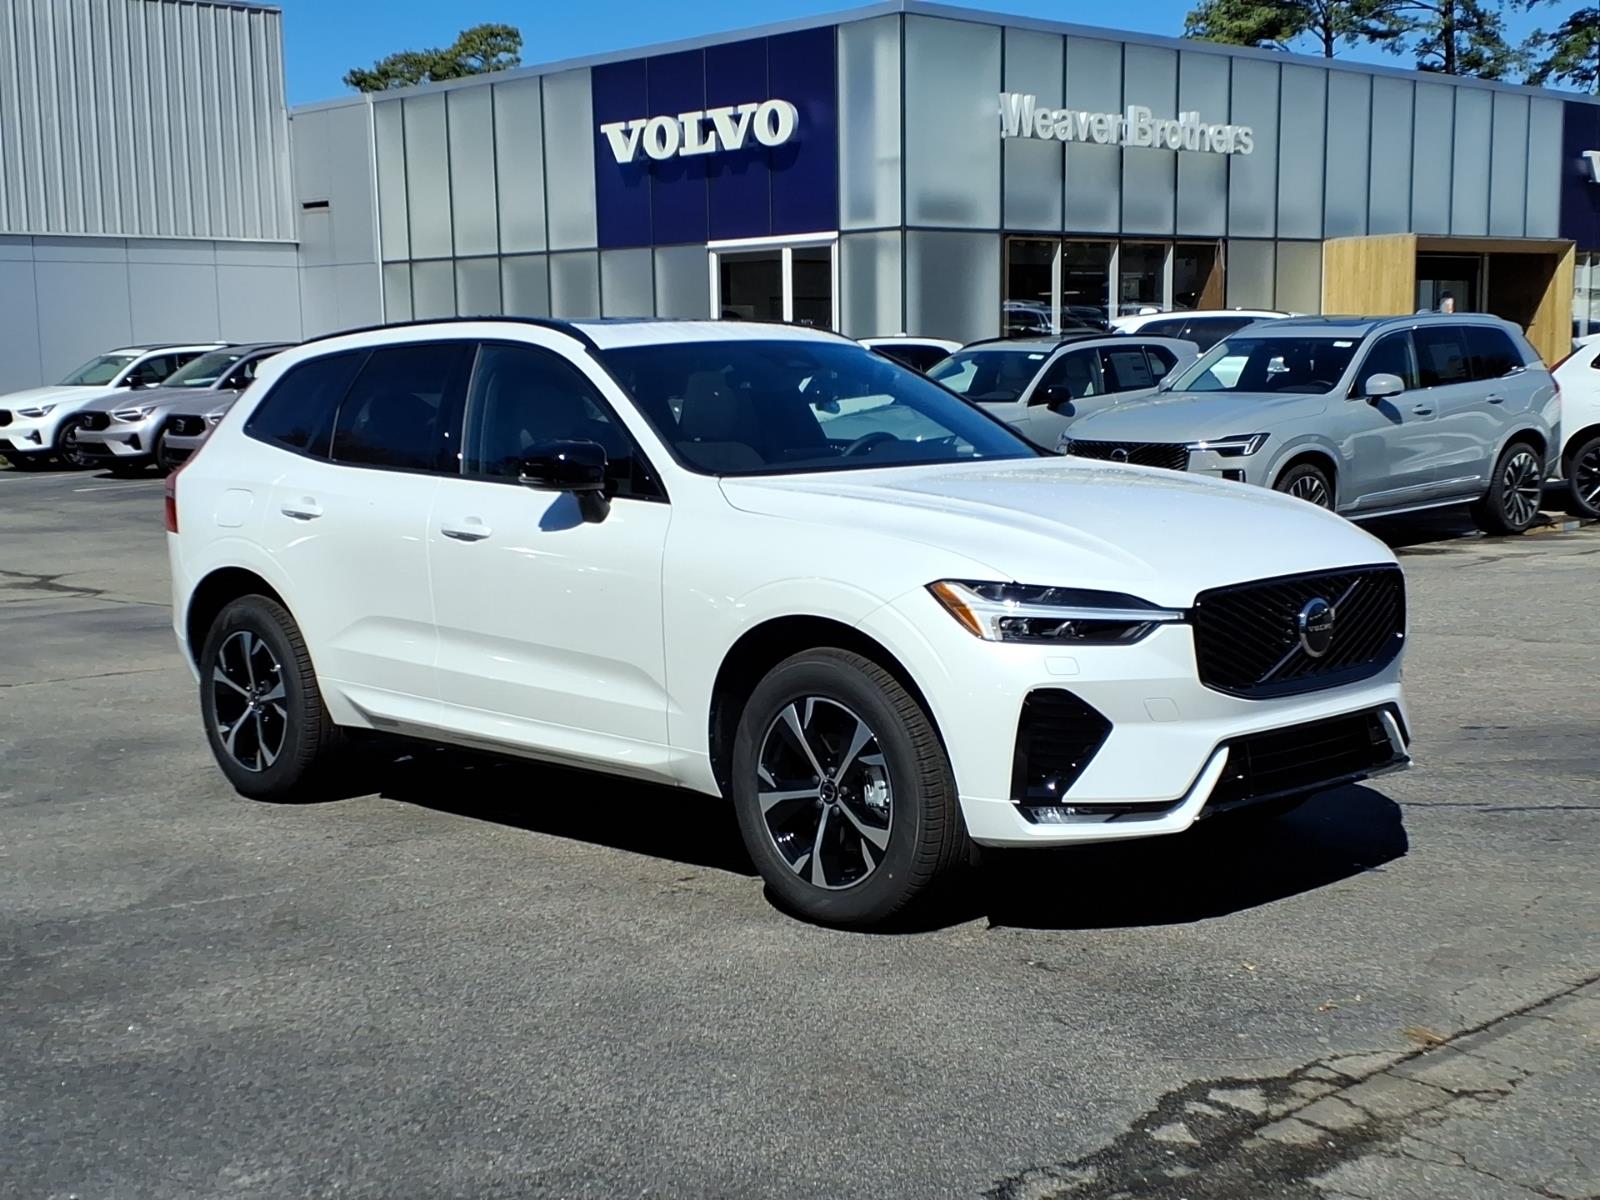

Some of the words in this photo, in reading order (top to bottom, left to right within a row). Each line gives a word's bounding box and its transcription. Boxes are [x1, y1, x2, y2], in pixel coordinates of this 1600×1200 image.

[600, 99, 798, 163] VOLVO
[999, 92, 1122, 144] Weaver
[1127, 105, 1254, 155] Brothers
